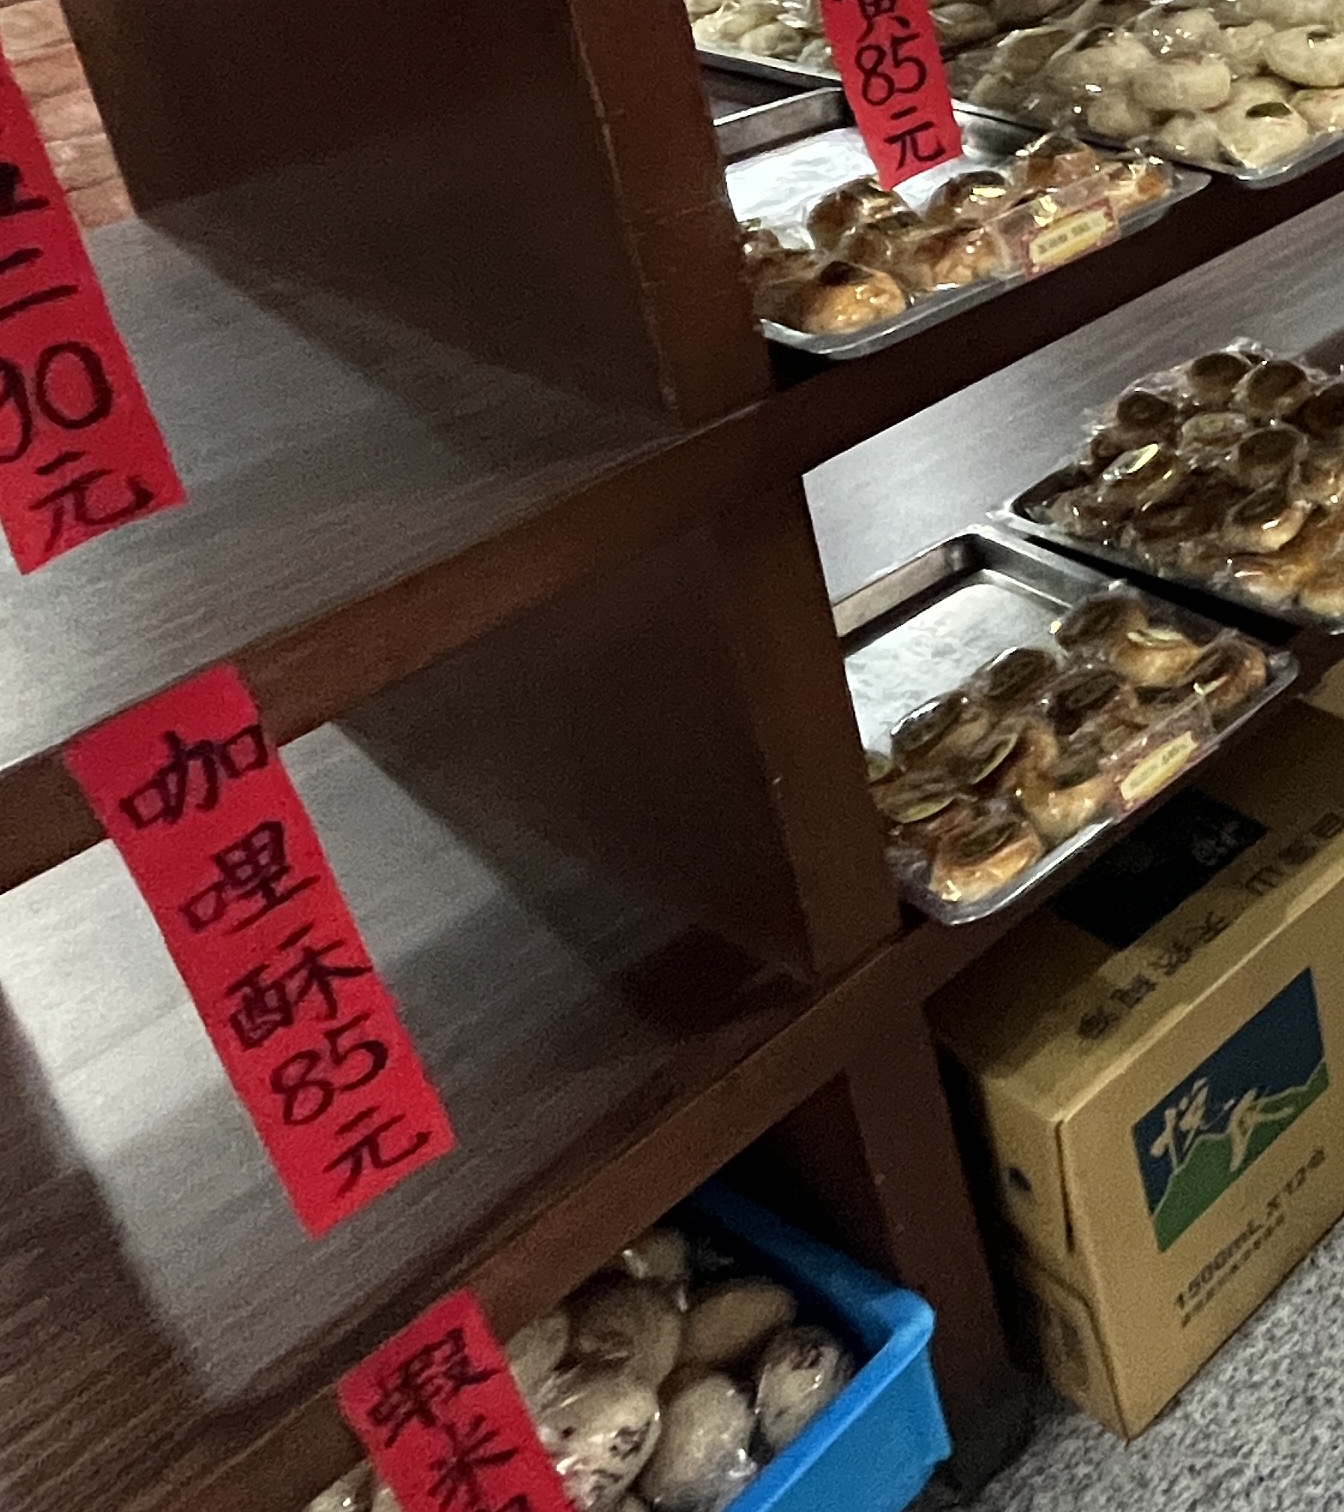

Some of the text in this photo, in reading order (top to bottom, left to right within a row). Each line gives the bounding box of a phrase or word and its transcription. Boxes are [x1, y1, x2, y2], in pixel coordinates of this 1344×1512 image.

[119, 724, 433, 1199] 咖哩酥85元
[366, 1326, 535, 1512] 蝦米
